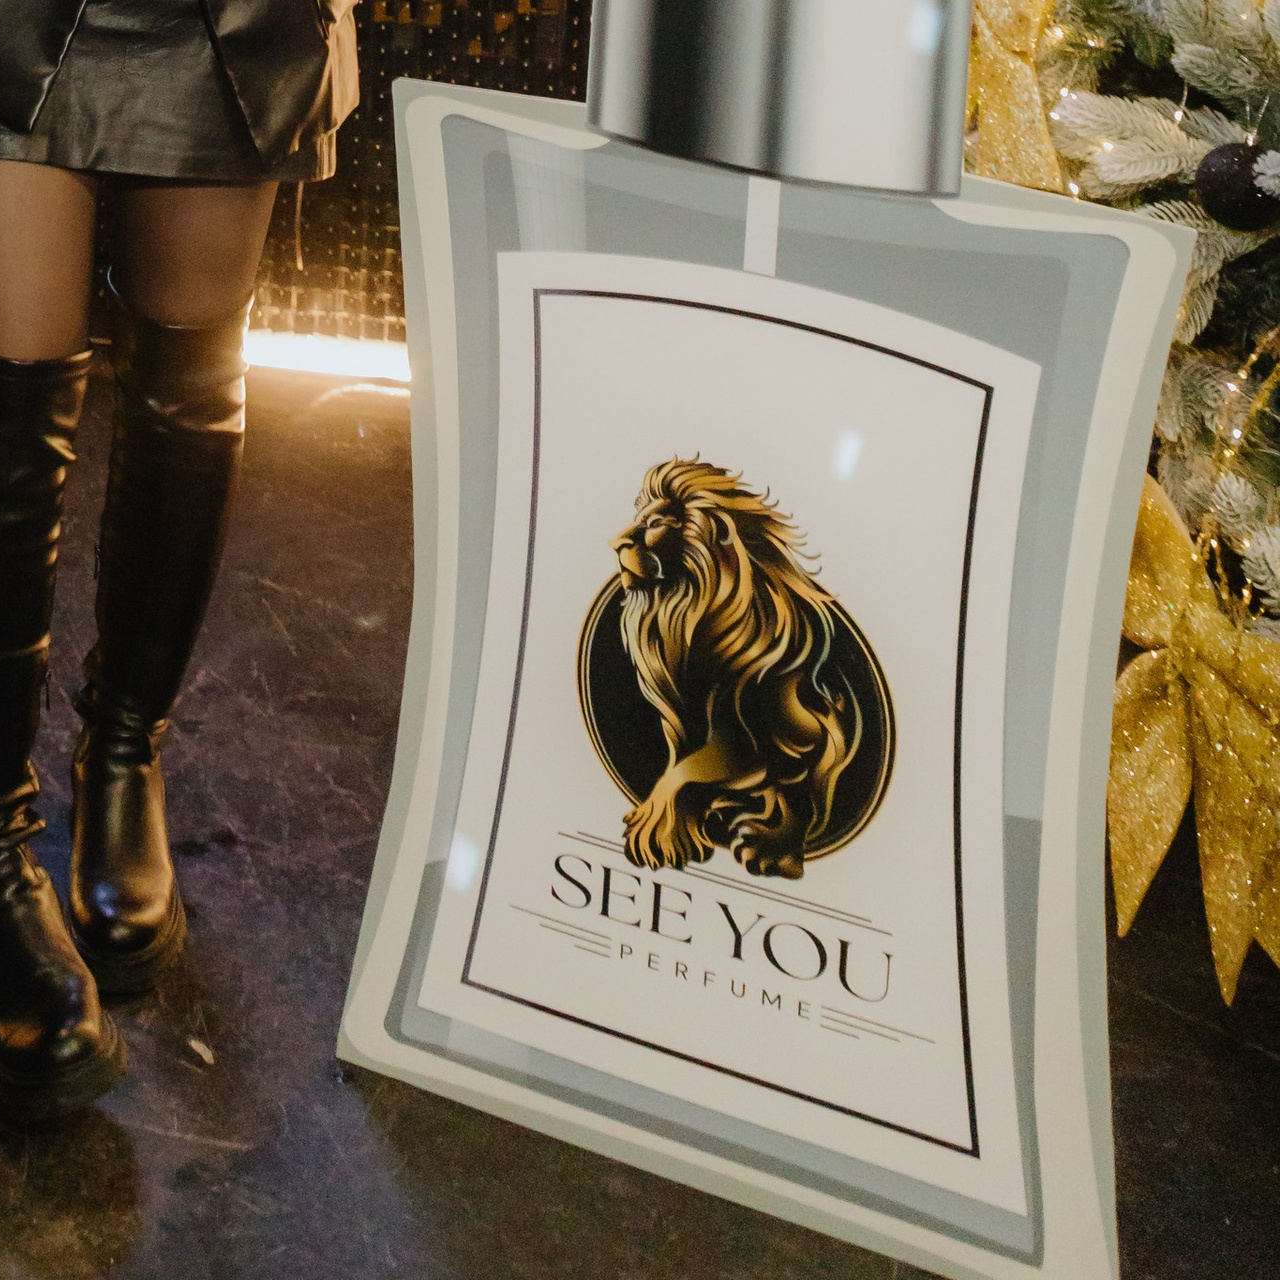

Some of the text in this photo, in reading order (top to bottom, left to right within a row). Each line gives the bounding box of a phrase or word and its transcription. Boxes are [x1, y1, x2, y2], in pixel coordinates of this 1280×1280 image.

[550, 852, 894, 1003] SEE YOU
[619, 943, 812, 1021] PERFUME
